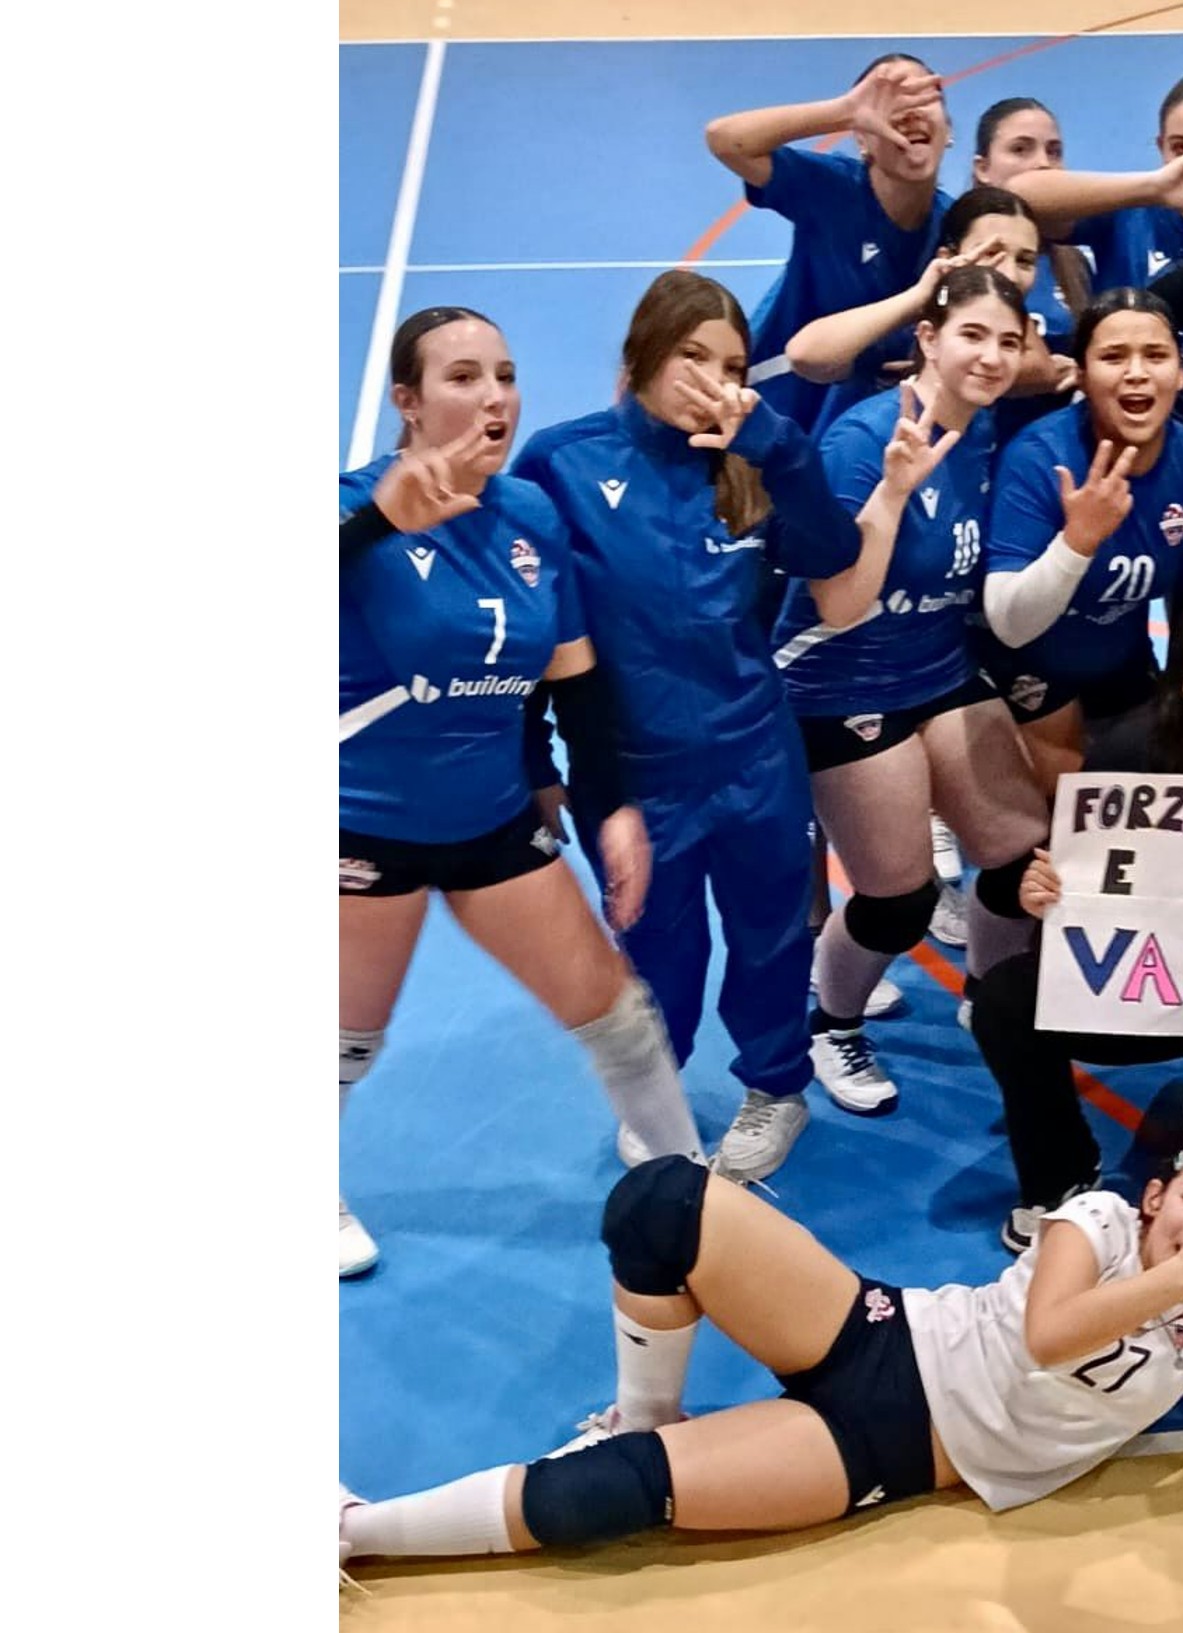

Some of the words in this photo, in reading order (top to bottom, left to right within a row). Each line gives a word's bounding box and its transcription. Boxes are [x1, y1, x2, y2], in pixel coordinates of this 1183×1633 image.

[945, 519, 981, 578] 10
[1098, 554, 1155, 603] 20
[477, 598, 506, 665] 7
[447, 675, 540, 698] buildin
[1101, 849, 1136, 896] E
[1070, 1338, 1152, 1393] 27
